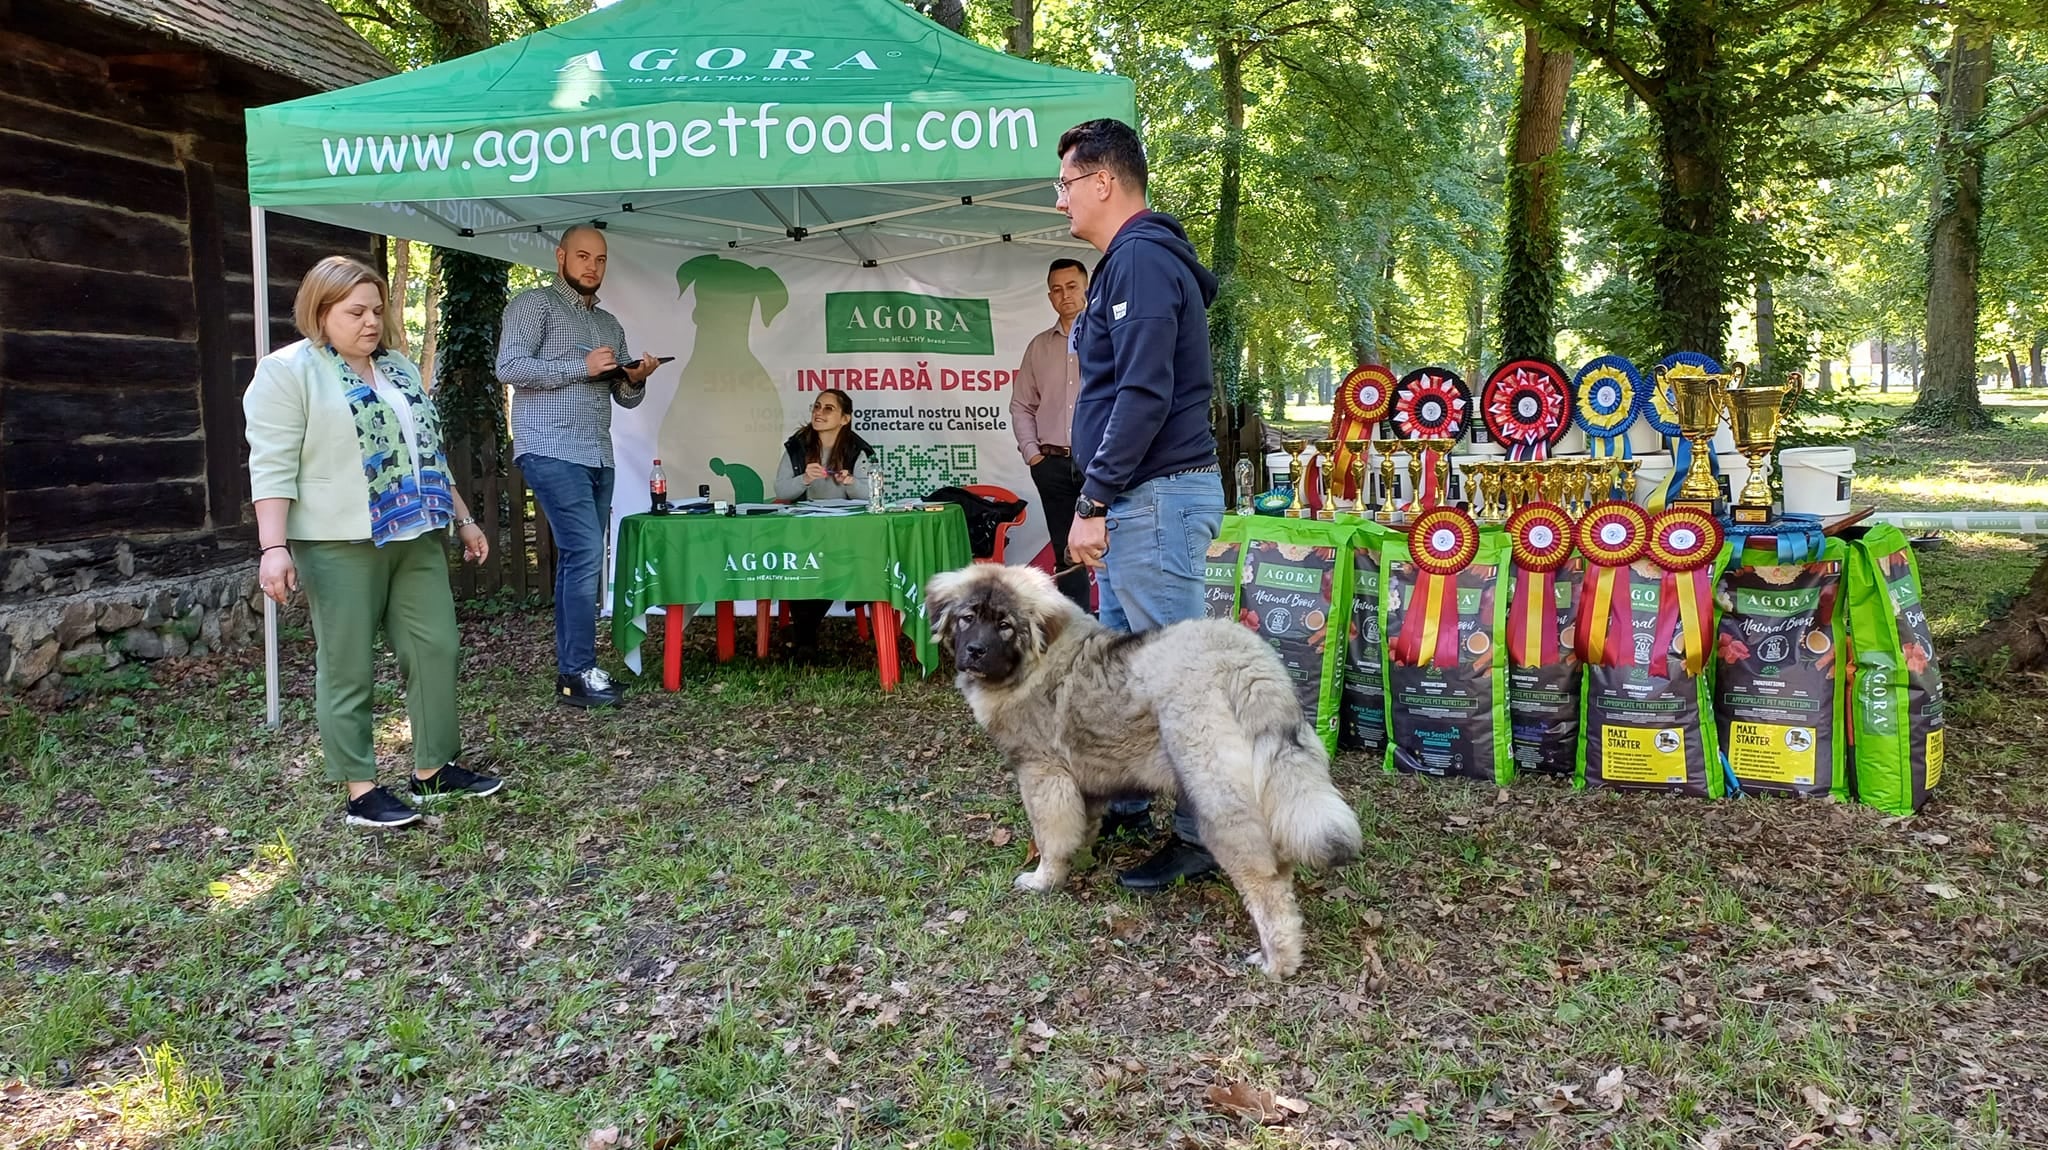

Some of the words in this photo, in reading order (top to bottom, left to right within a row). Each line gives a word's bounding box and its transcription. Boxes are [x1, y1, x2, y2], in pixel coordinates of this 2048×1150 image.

[660, 75, 756, 83] HEALTHY
[322, 101, 1039, 183] www.agorapetfood.com
[846, 305, 971, 333] AGORA
[891, 336, 926, 344] HEALTHY
[797, 361, 933, 392] INTREABĂ
[940, 369, 1020, 392] DESP
[853, 405, 914, 422] ogramul
[918, 407, 961, 419] nostru
[965, 406, 1001, 419] NOU
[854, 420, 925, 432] conectare
[928, 422, 944, 432] cu
[946, 418, 1008, 432] Canisele
[723, 552, 820, 571] AGORA
[1205, 567, 1233, 578] ORA
[1264, 569, 1315, 584] AGORA
[1252, 589, 1291, 607] Natural
[1290, 593, 1316, 608] Boost
[1747, 593, 1810, 608] AGORA
[1739, 617, 1786, 636] Natural
[1785, 616, 1816, 631] Boost
[1872, 660, 1889, 725] AGORA
[1607, 728, 1628, 739] MAXI
[1736, 724, 1758, 735] MAXI
[1607, 738, 1641, 750] STARTER
[1736, 734, 1770, 746] STARTER
